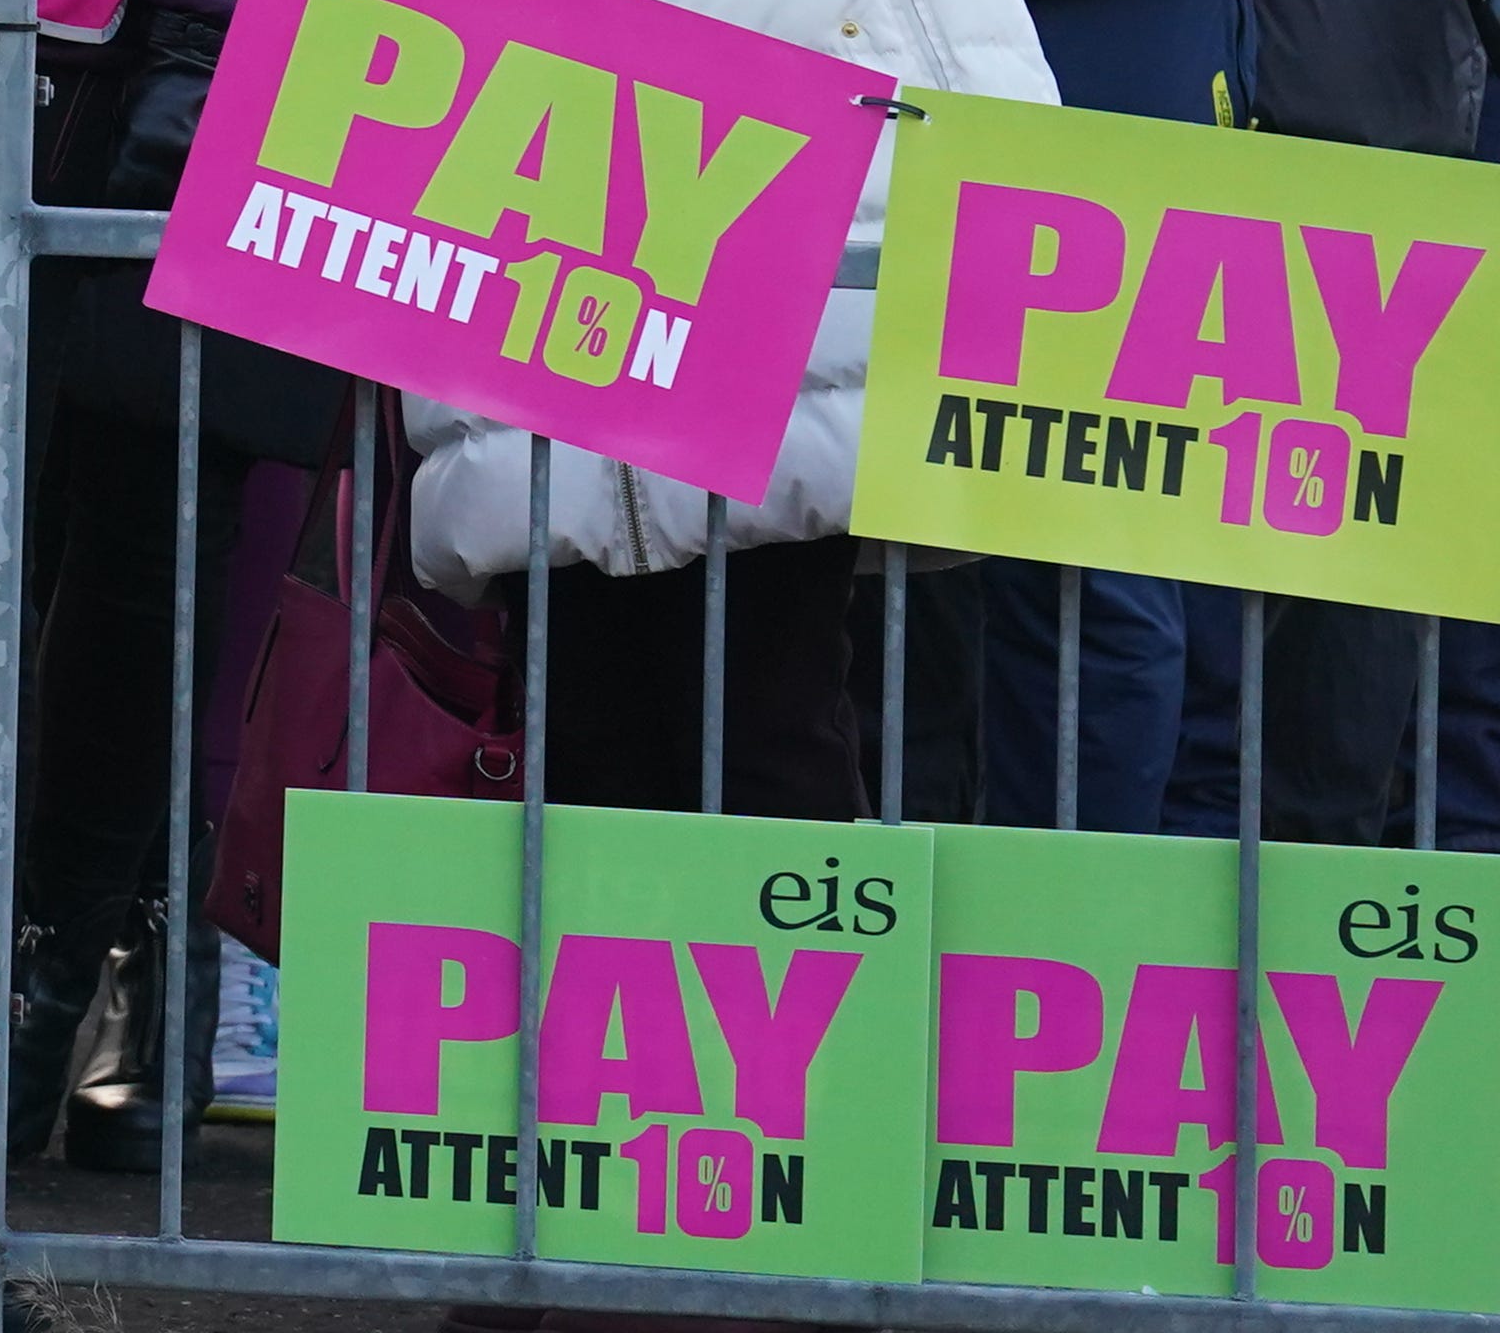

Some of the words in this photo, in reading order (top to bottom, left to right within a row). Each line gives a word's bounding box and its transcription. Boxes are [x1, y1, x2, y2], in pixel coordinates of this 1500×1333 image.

[938, 179, 1486, 438] PAY
[759, 856, 898, 936] eis
[1337, 884, 1480, 965] eis
[363, 921, 864, 1140] PAY
[936, 952, 1445, 1170] PAY
